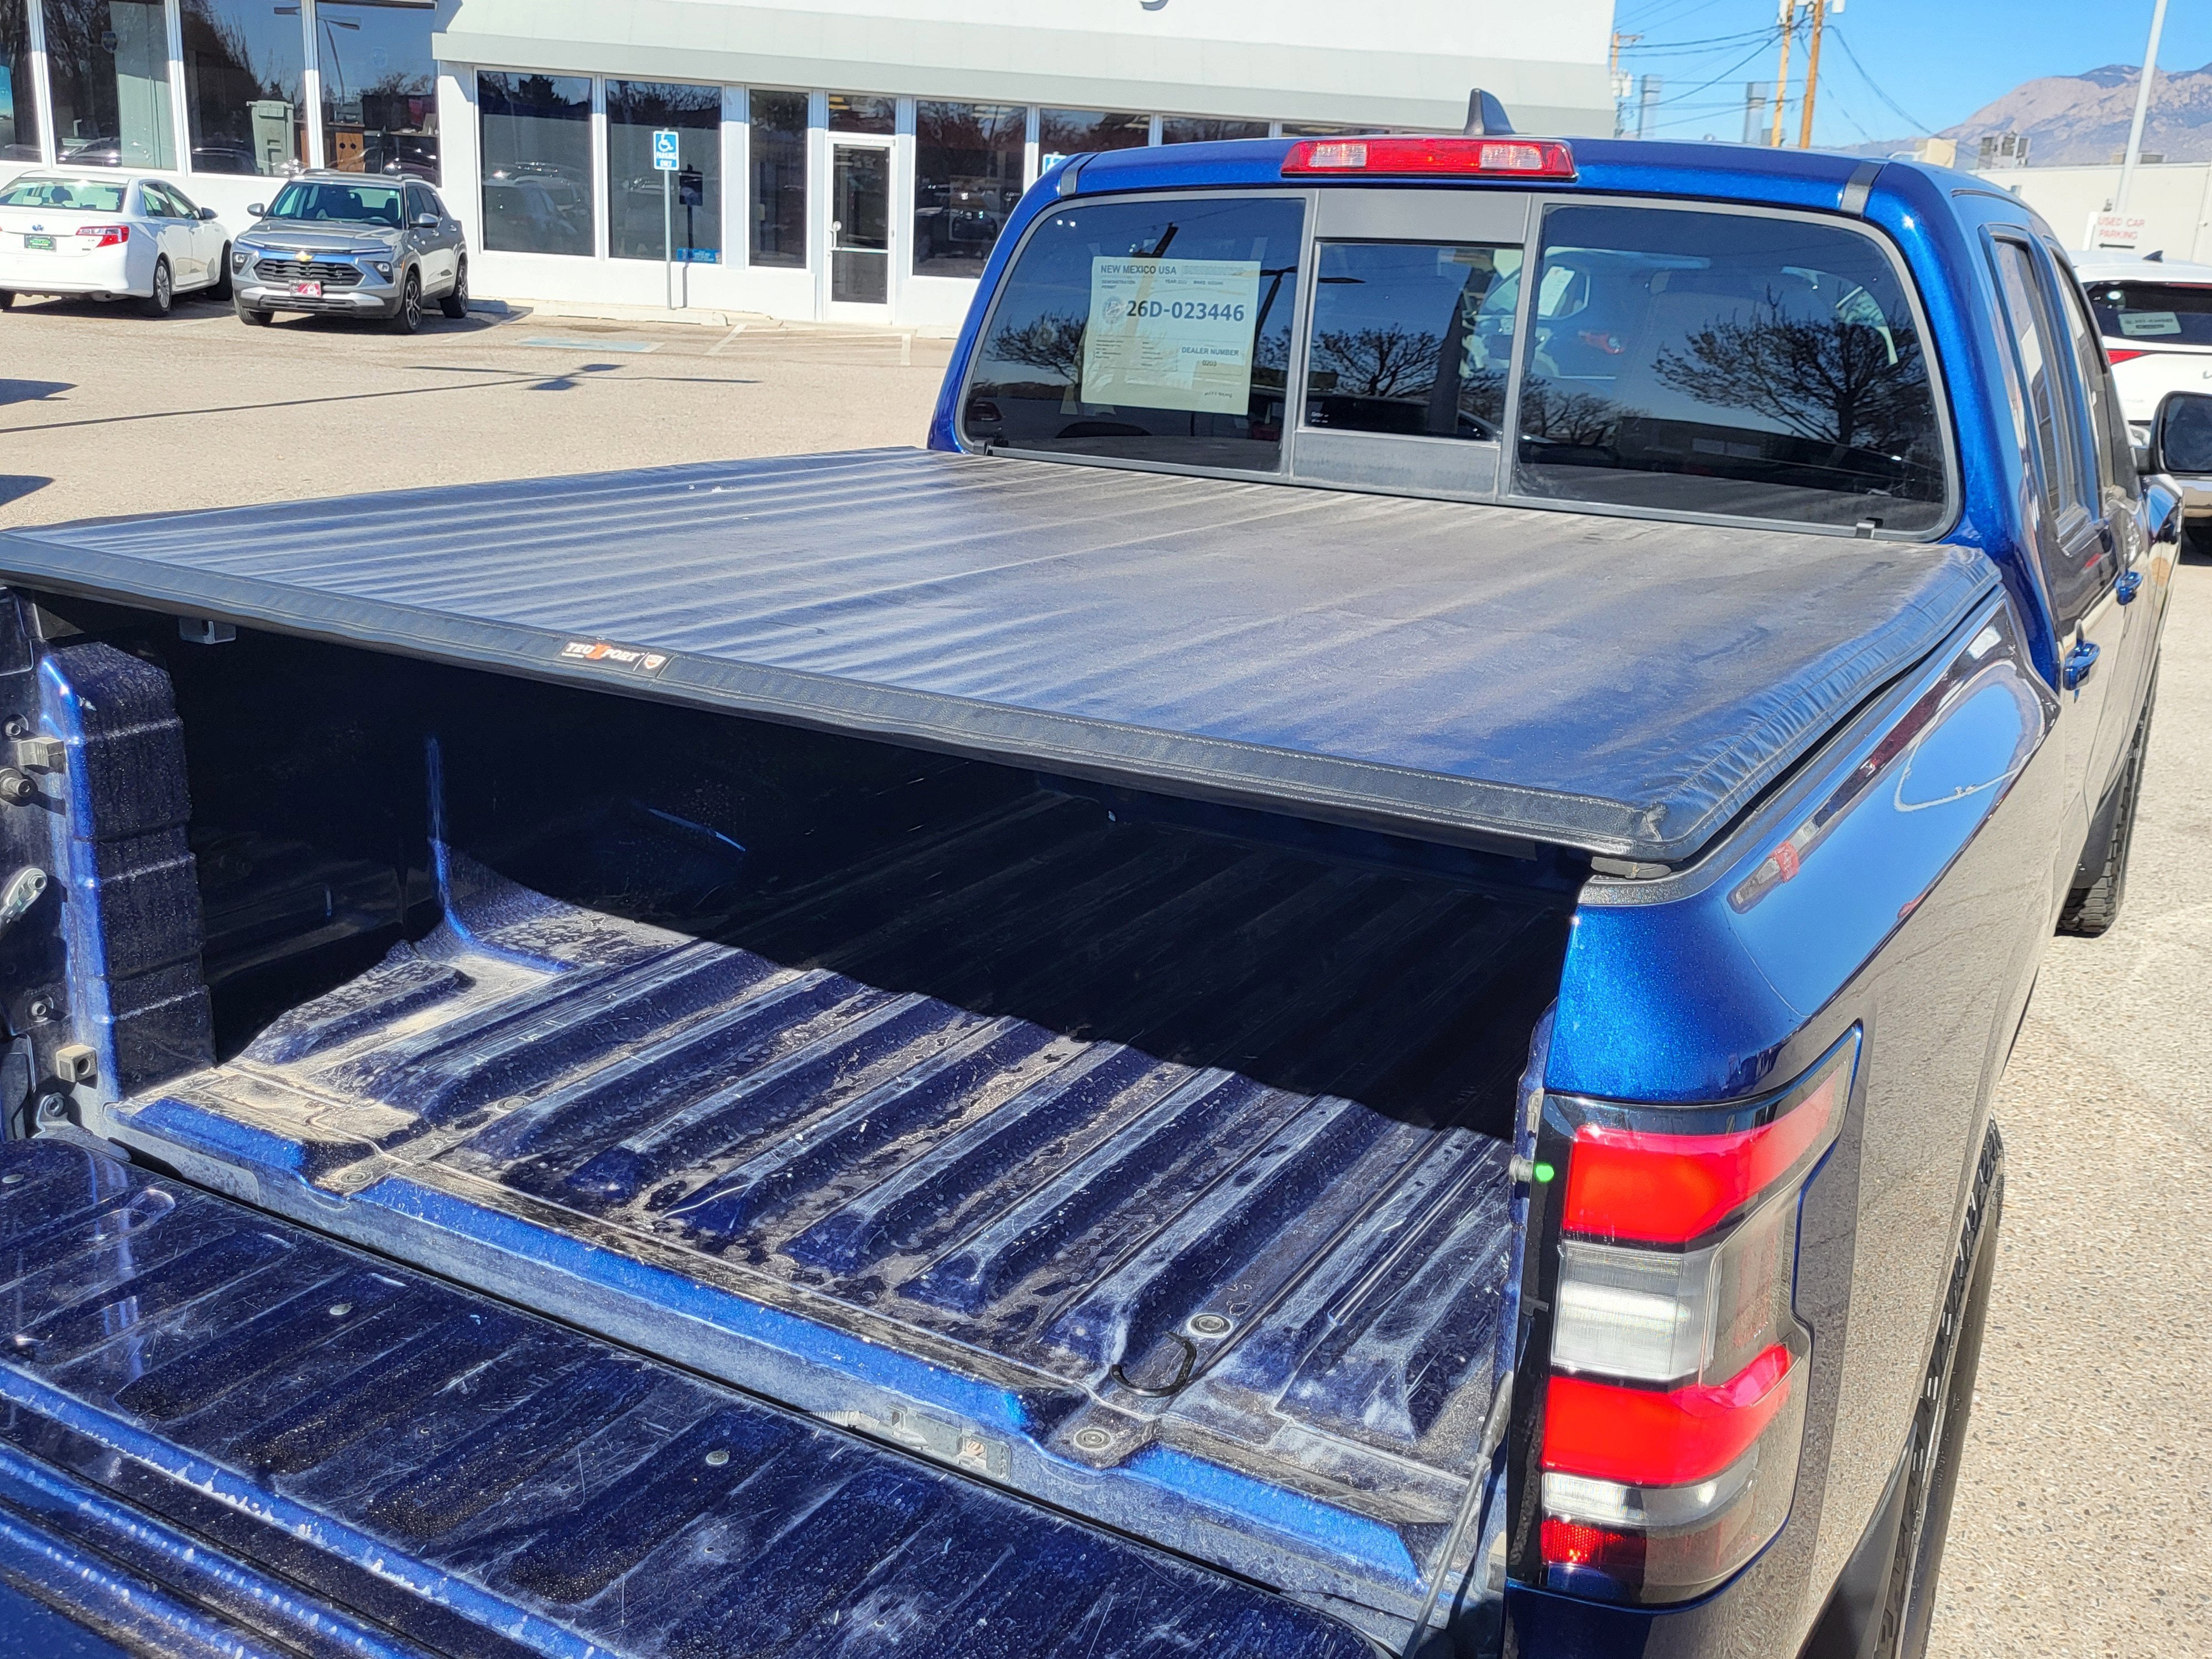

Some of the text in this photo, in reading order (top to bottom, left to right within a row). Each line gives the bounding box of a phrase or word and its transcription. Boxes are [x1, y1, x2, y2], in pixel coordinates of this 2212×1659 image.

[1100, 264, 1121, 274] NEW
[1123, 265, 1156, 274] MEXICO
[1159, 266, 1177, 275] USA
[1126, 300, 1244, 322] 26D-023446
[1182, 346, 1209, 354] DEALER
